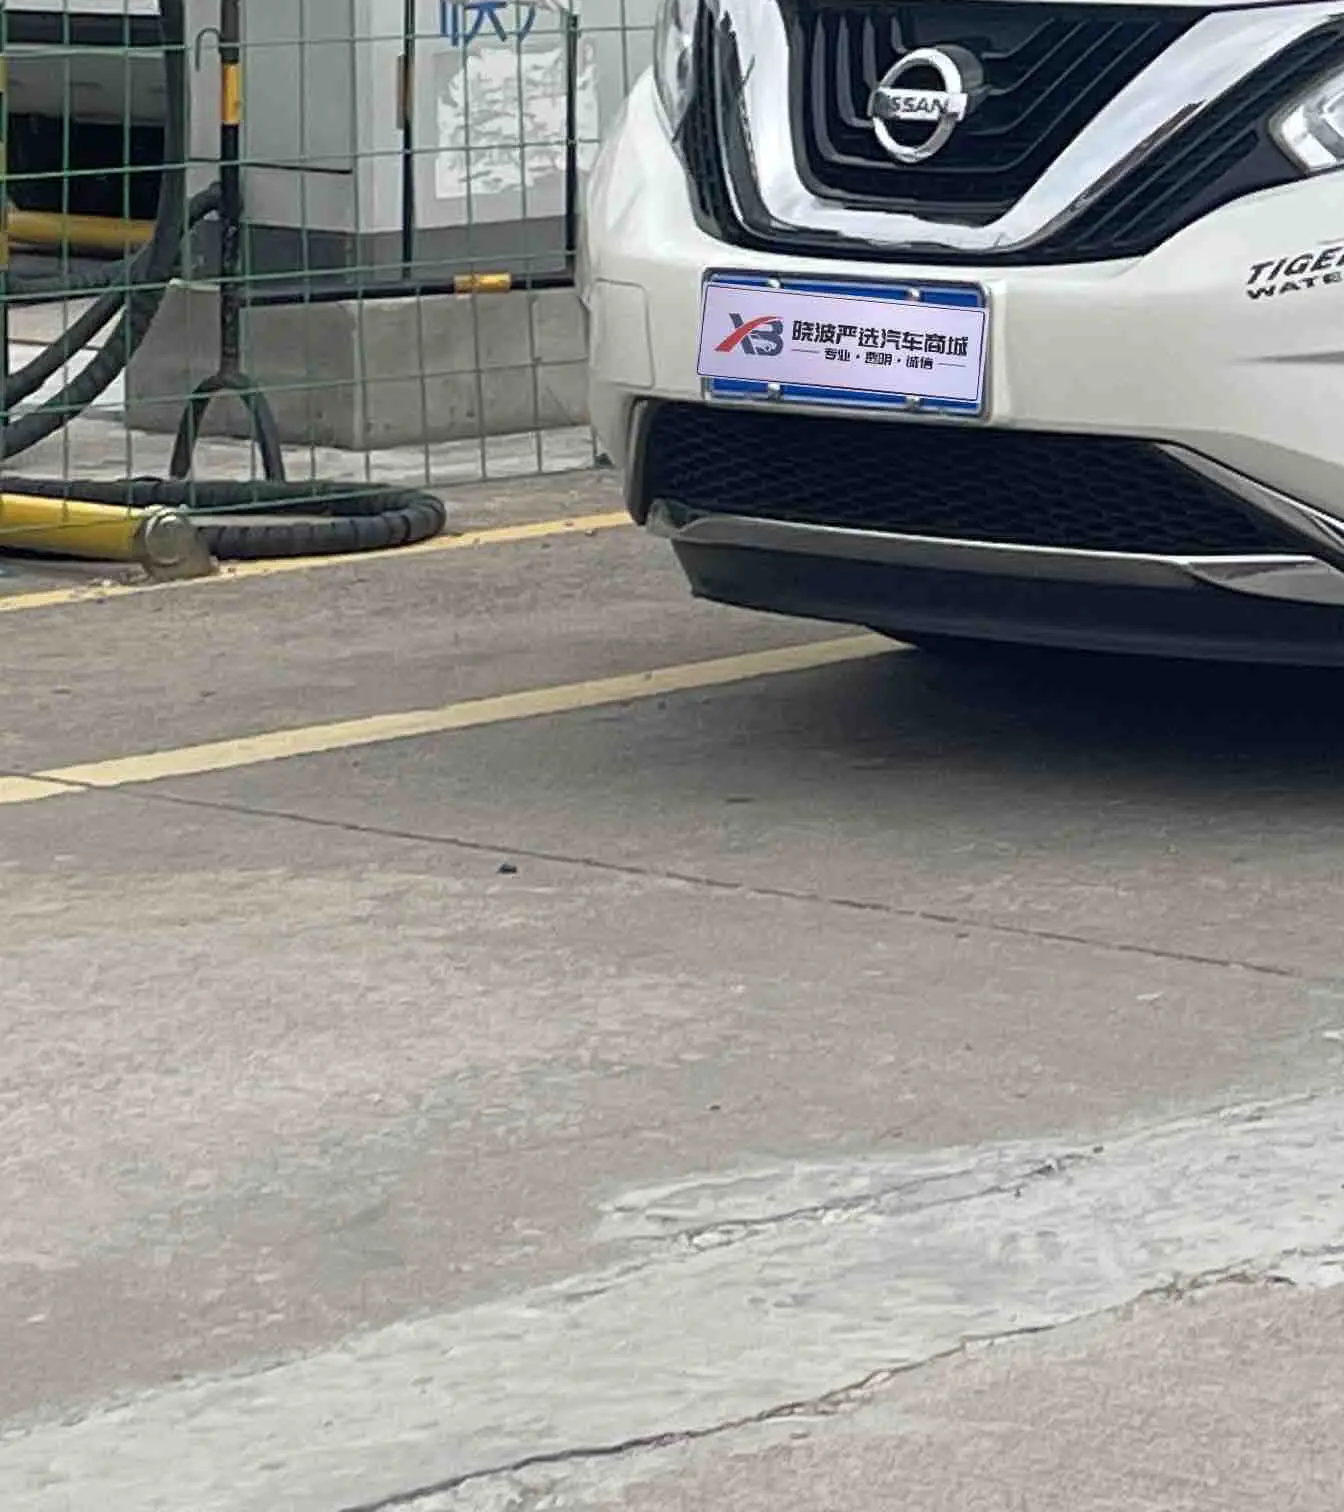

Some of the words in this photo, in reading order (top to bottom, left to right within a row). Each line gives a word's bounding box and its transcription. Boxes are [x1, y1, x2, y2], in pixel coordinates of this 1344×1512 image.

[791, 320, 968, 356] 晓波严选汽车商城
